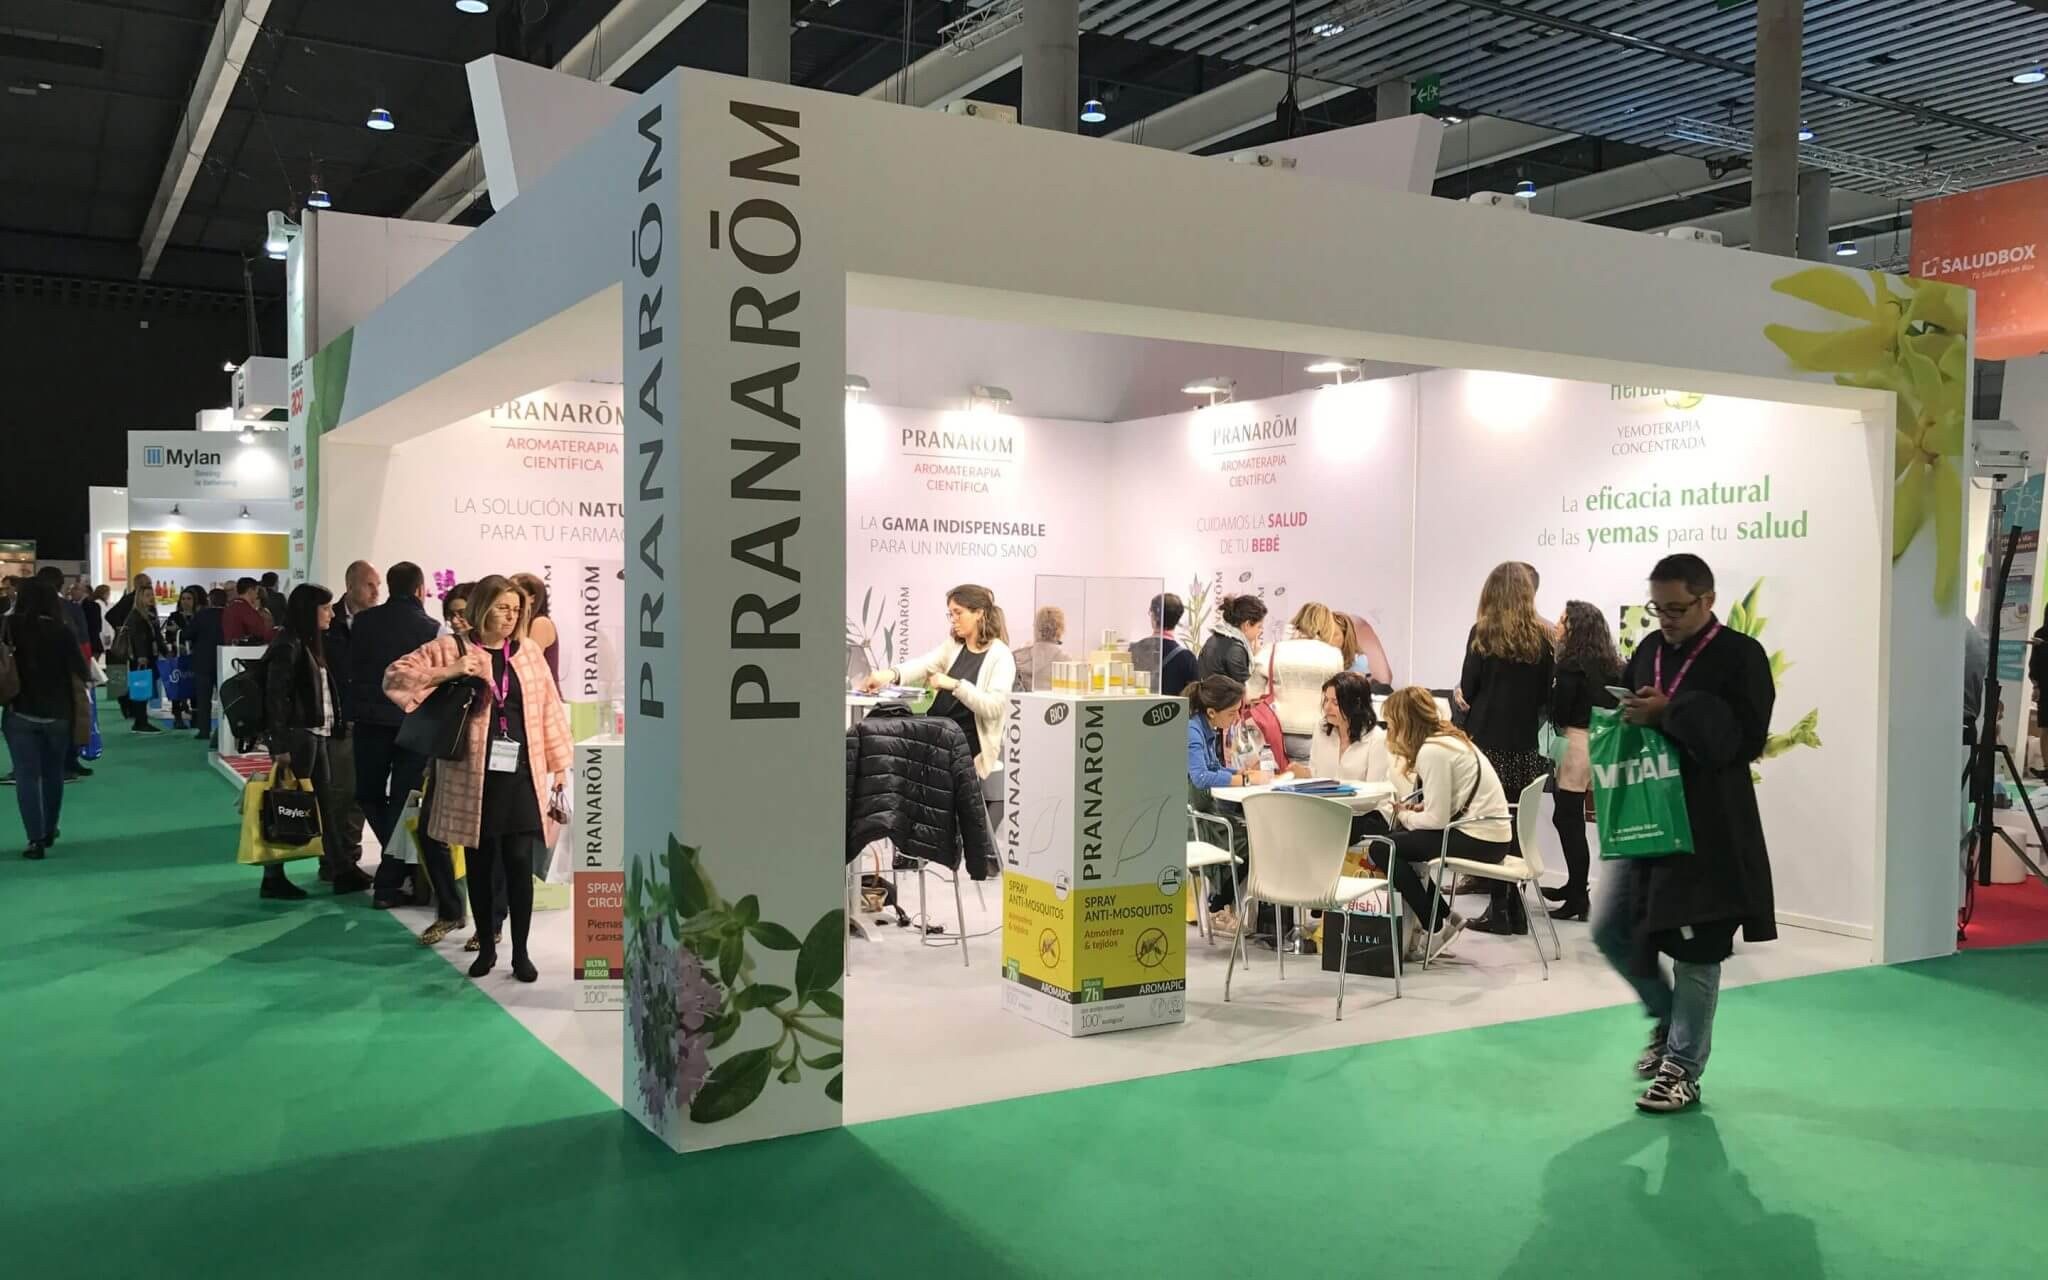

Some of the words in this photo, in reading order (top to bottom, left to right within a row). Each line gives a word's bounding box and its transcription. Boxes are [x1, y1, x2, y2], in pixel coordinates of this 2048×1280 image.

[1941, 244, 2037, 274] SALUDBOX
[632, 104, 664, 718] PRANARŌM
[710, 100, 801, 720] PRANARŌM
[1617, 420, 1700, 438] YEMOTERAPIA
[506, 436, 619, 454] AROMATERAPIA
[1611, 437, 1706, 456] CONCENTRADA
[166, 449, 221, 468] Mylan
[523, 455, 604, 471] CIENTÍFICA
[1221, 455, 1287, 472] AROMATERAPIA
[914, 463, 1001, 478] AROMATERAPIA
[926, 479, 989, 494] CIENTÍFICA
[1562, 496, 1578, 512] La
[1586, 483, 1671, 511] eficacia
[1681, 475, 1770, 507] natural
[454, 498, 476, 513] LA
[482, 497, 573, 516] SOLUCIÓN
[860, 515, 878, 530] LA
[882, 517, 929, 533] GAMA
[933, 519, 1046, 537] INDISPENSABLE
[1253, 514, 1266, 529] LA
[1268, 512, 1308, 528] SALUD
[480, 524, 527, 540] PARA
[532, 525, 553, 541] TU
[1538, 528, 1556, 546] de
[1561, 528, 1580, 545] las
[1587, 522, 1659, 552] yemas
[1667, 527, 1705, 548] para
[1710, 524, 1727, 541] tu
[1736, 510, 1808, 541] salud
[870, 538, 907, 553] PARA
[911, 540, 932, 554] UN
[935, 541, 998, 557] INVIERNO
[1001, 543, 1038, 558] SANO
[1252, 535, 1280, 552] BEBÉ
[580, 566, 600, 695] PRANARŌM
[1007, 699, 1022, 866] PRANARŌM
[1080, 706, 1104, 881] PRANARŌM
[582, 748, 602, 867] PRANARŌM
[587, 882, 624, 894] SPRAY
[1008, 880, 1029, 895] SPRAY
[1008, 894, 1064, 920] ANTI-MOSQUITOS
[1084, 895, 1116, 908] SPRAY
[1084, 904, 1173, 921] ANTI-MOSQUITOS
[1085, 987, 1099, 1002] 7h
[1139, 980, 1185, 994] AROMAPIC
